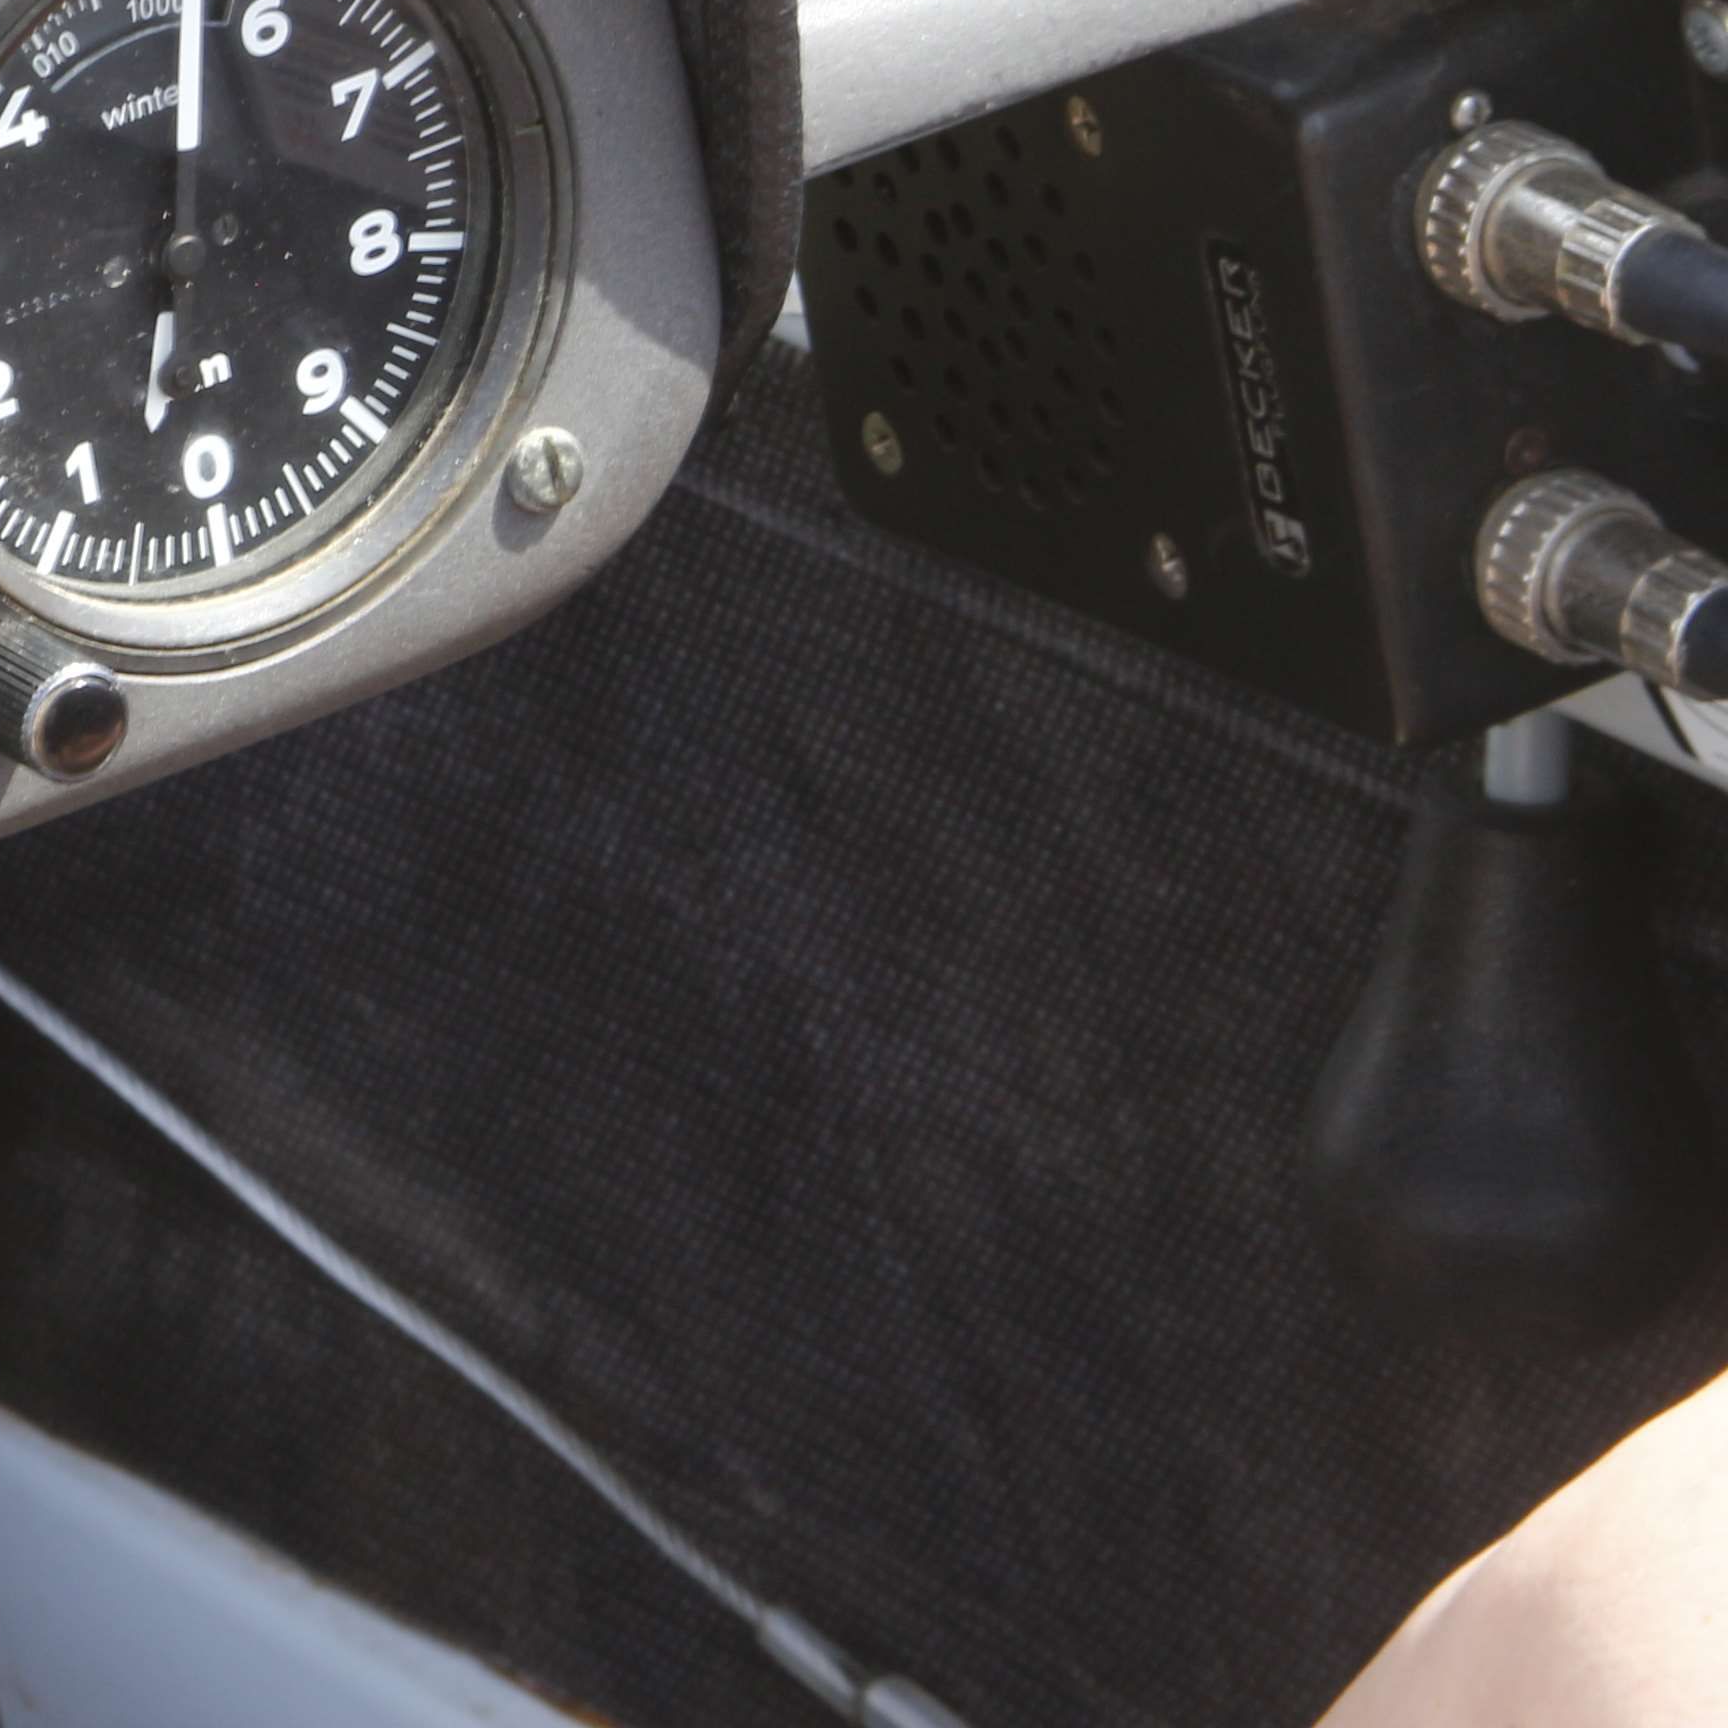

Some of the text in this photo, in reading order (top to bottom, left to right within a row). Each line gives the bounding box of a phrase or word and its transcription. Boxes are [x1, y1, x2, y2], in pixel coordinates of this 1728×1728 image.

[101, 83, 180, 130] winte
[331, 69, 382, 141] 7
[349, 209, 401, 277] 8
[295, 348, 345, 415] 9
[65, 440, 102, 504] 1
[182, 433, 233, 499] 0
